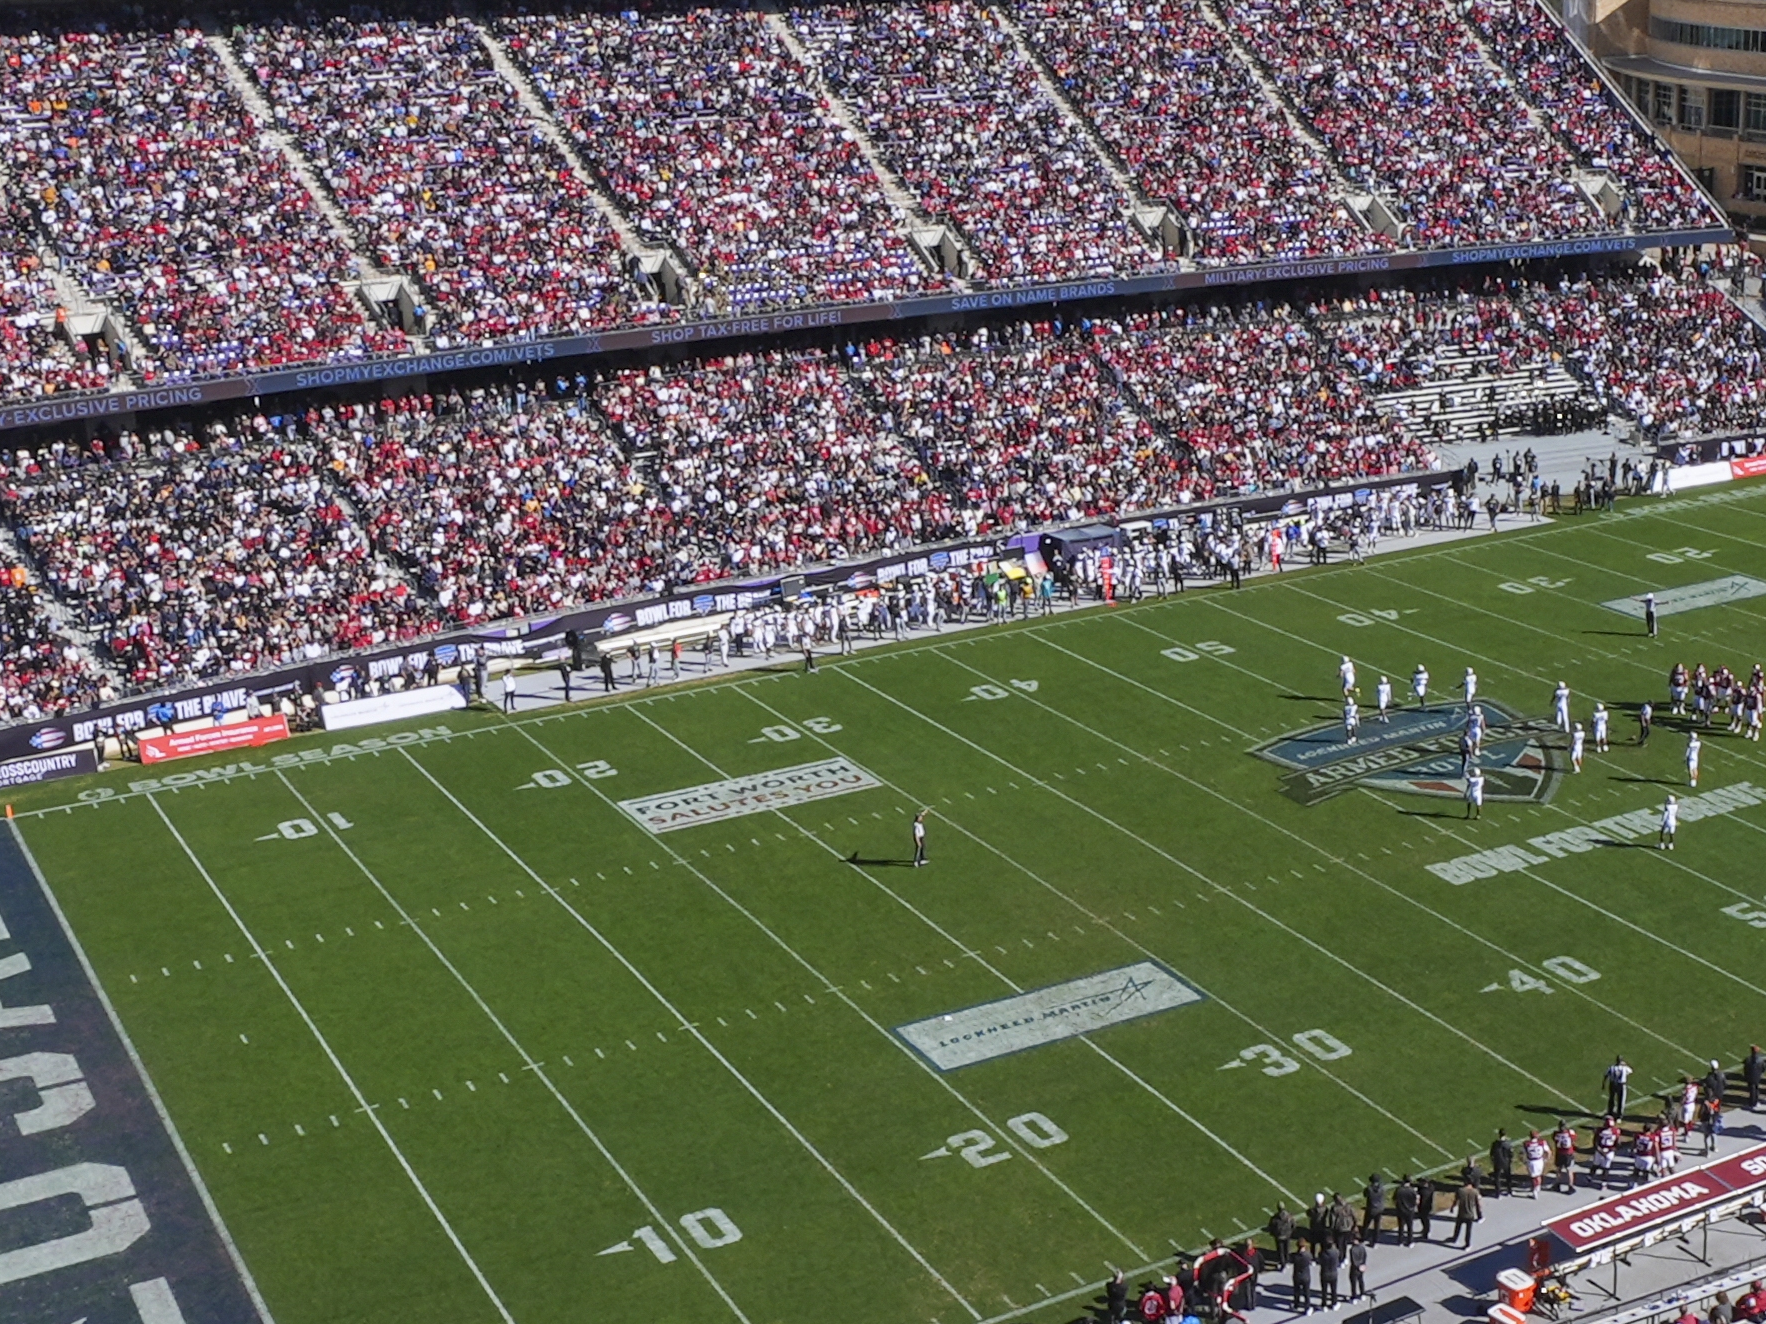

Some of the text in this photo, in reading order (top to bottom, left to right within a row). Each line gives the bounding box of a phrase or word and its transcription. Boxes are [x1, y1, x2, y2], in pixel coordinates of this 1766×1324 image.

[951, 282, 1116, 311] SAVE ON NAME BRANDS
[651, 326, 694, 344] SHOP
[699, 318, 770, 340] TAX-FREE
[773, 314, 804, 329] FOR
[296, 342, 556, 388] SHOPMYEXCHANGE.COM/VETS
[125, 386, 203, 414] PRICING
[636, 602, 668, 628] BOWL
[669, 598, 692, 620] FOR
[1161, 640, 1236, 664] 50
[174, 697, 209, 720] THE
[759, 715, 844, 743] 30
[1382, 719, 1448, 742] MARTIN
[128, 761, 266, 793] BOWL
[269, 725, 454, 768] SEASON
[531, 758, 619, 790] 20
[1303, 747, 1422, 788] ARMED
[636, 765, 851, 815] FORT WORTH
[647, 774, 863, 826] SALUTES YOU
[276, 810, 356, 841] 10
[1424, 843, 1551, 886] BOWL
[1525, 825, 1601, 859] FOR
[1497, 953, 1602, 996] 40
[938, 995, 1111, 1048] LOCKHEED MARTIN
[1238, 1027, 1352, 1078] 30
[943, 1109, 1070, 1170] 20
[1569, 1180, 1710, 1238] OKLAHOMA
[626, 1205, 743, 1265] 10
